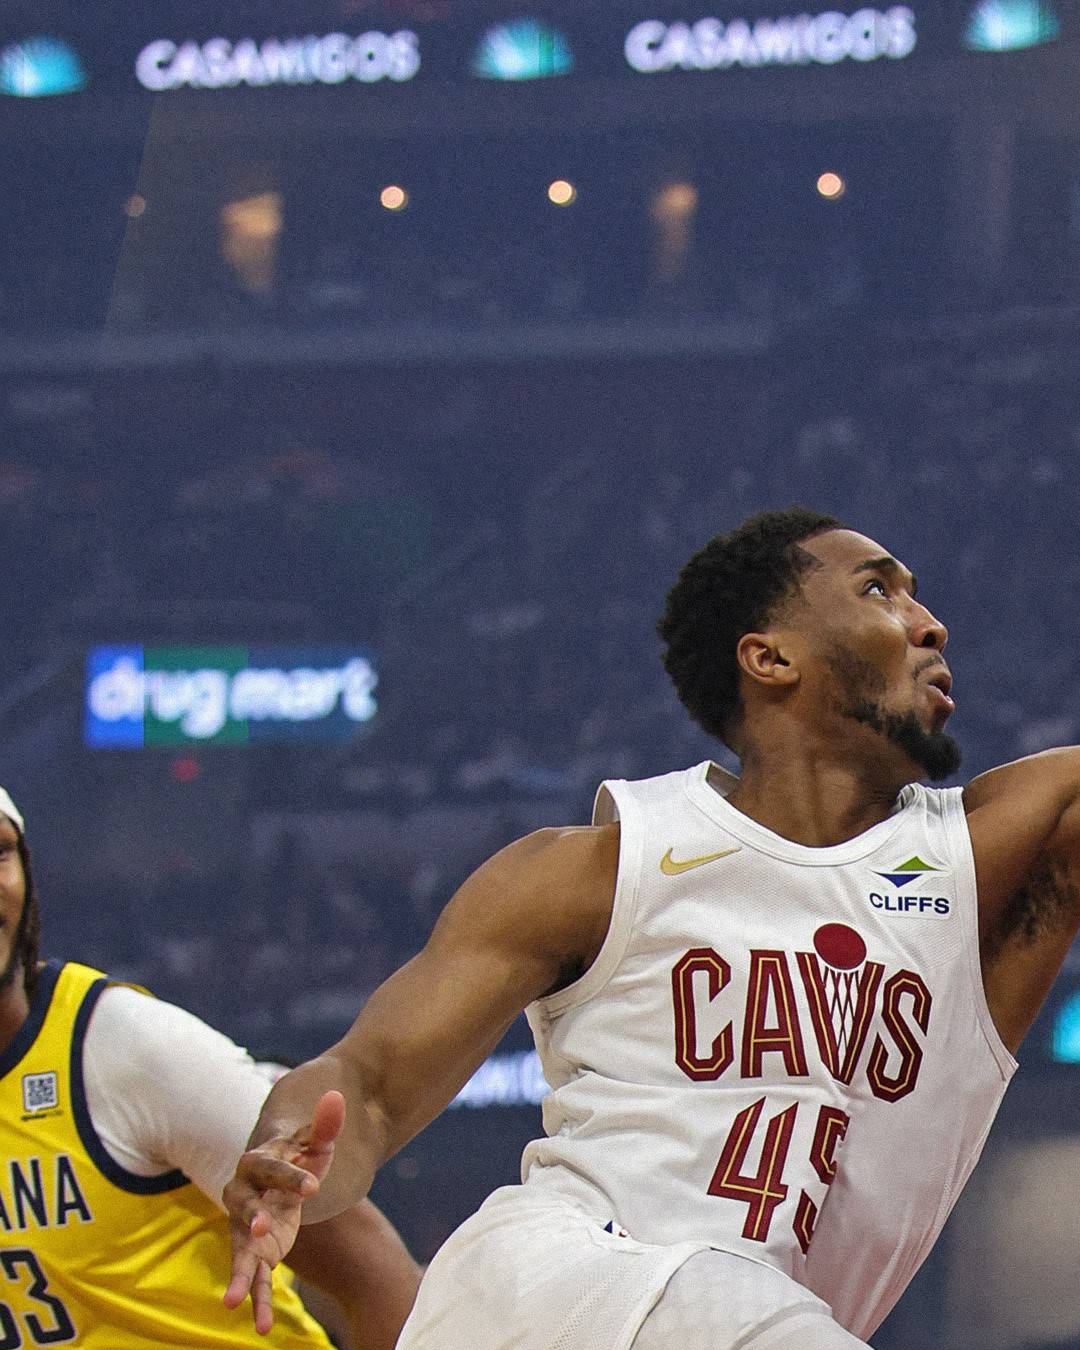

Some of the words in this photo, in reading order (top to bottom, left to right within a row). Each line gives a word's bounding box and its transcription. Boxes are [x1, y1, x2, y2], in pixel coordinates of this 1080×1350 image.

[136, 29, 420, 91] CASAMIGOS
[625, 6, 916, 72] CASAMIGOS
[88, 656, 227, 739] drug
[231, 656, 379, 721] mart
[869, 892, 950, 915] CLIFFS
[671, 946, 932, 1103] CAVS
